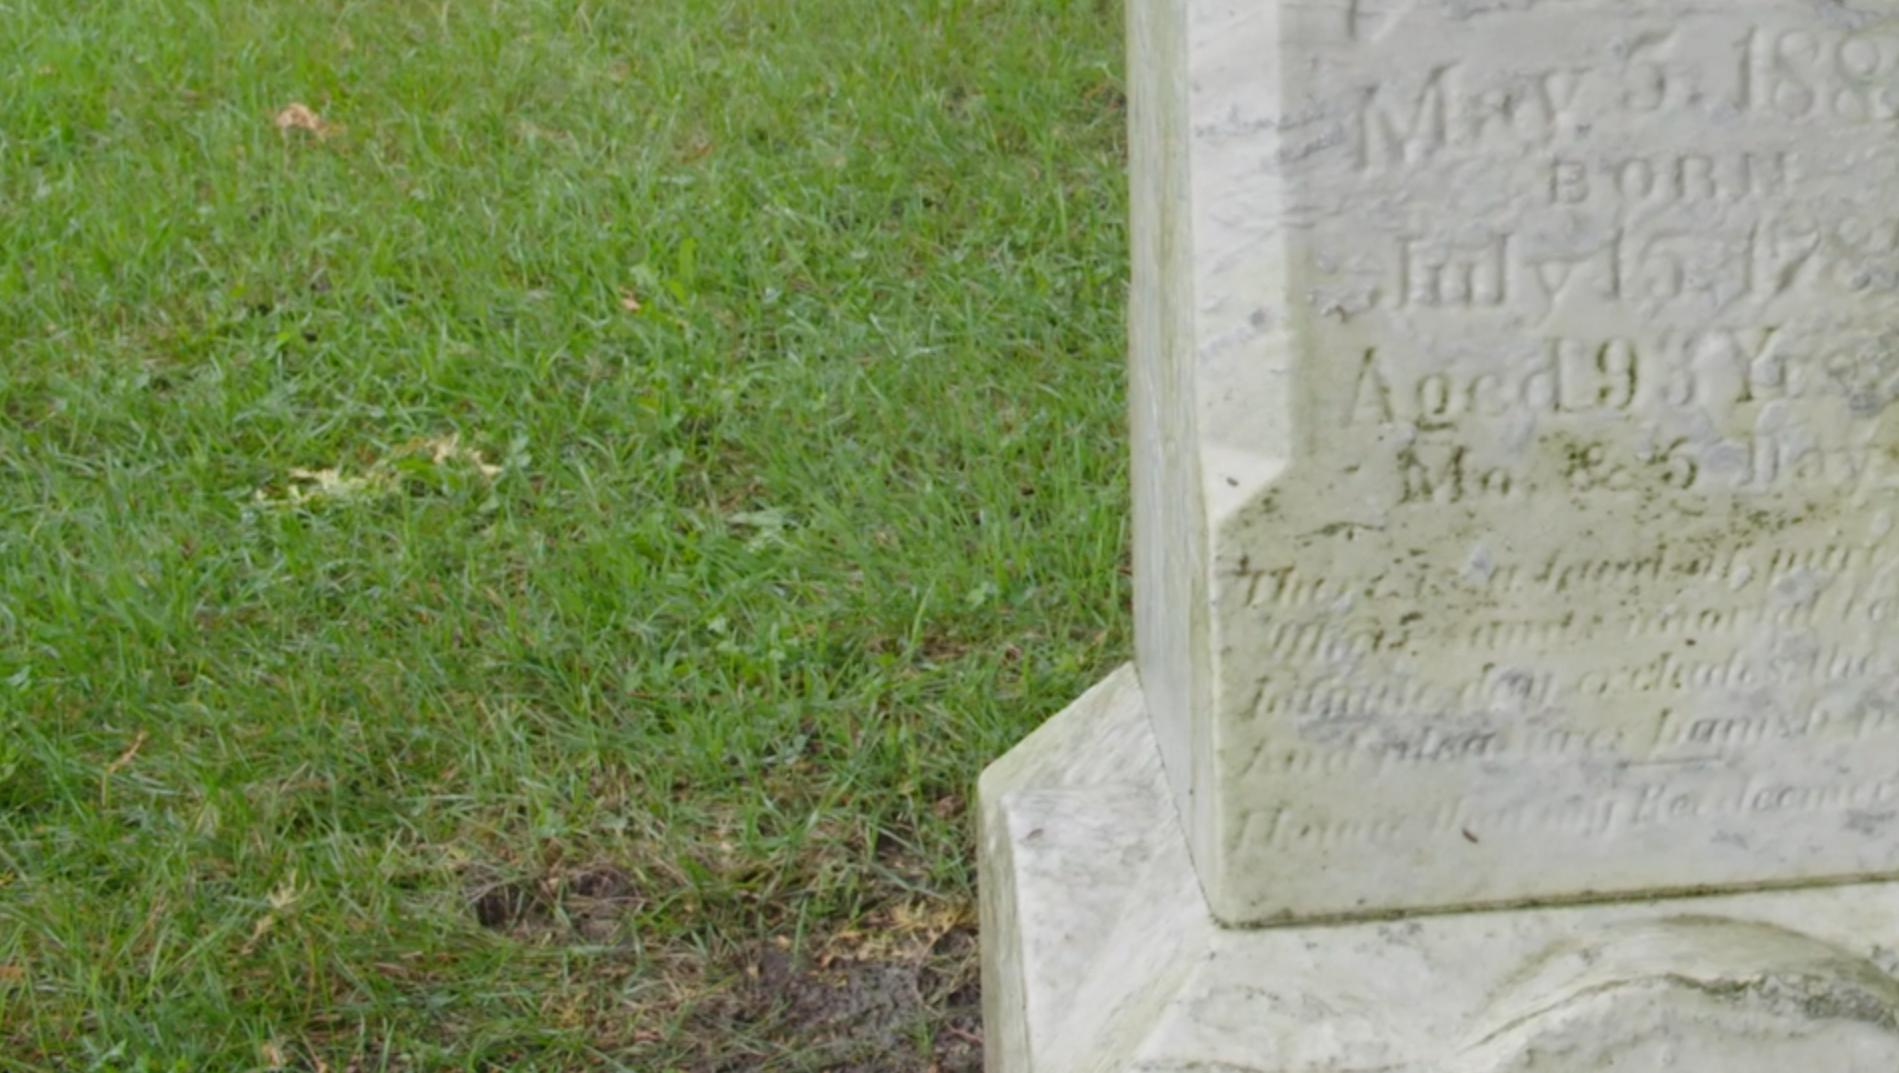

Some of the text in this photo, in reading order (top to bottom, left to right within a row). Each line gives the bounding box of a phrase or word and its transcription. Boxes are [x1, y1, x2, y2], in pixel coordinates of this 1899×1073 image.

[1358, 65, 1600, 177] May
[1548, 150, 1815, 207] BORN
[1342, 342, 1562, 435] Aged
